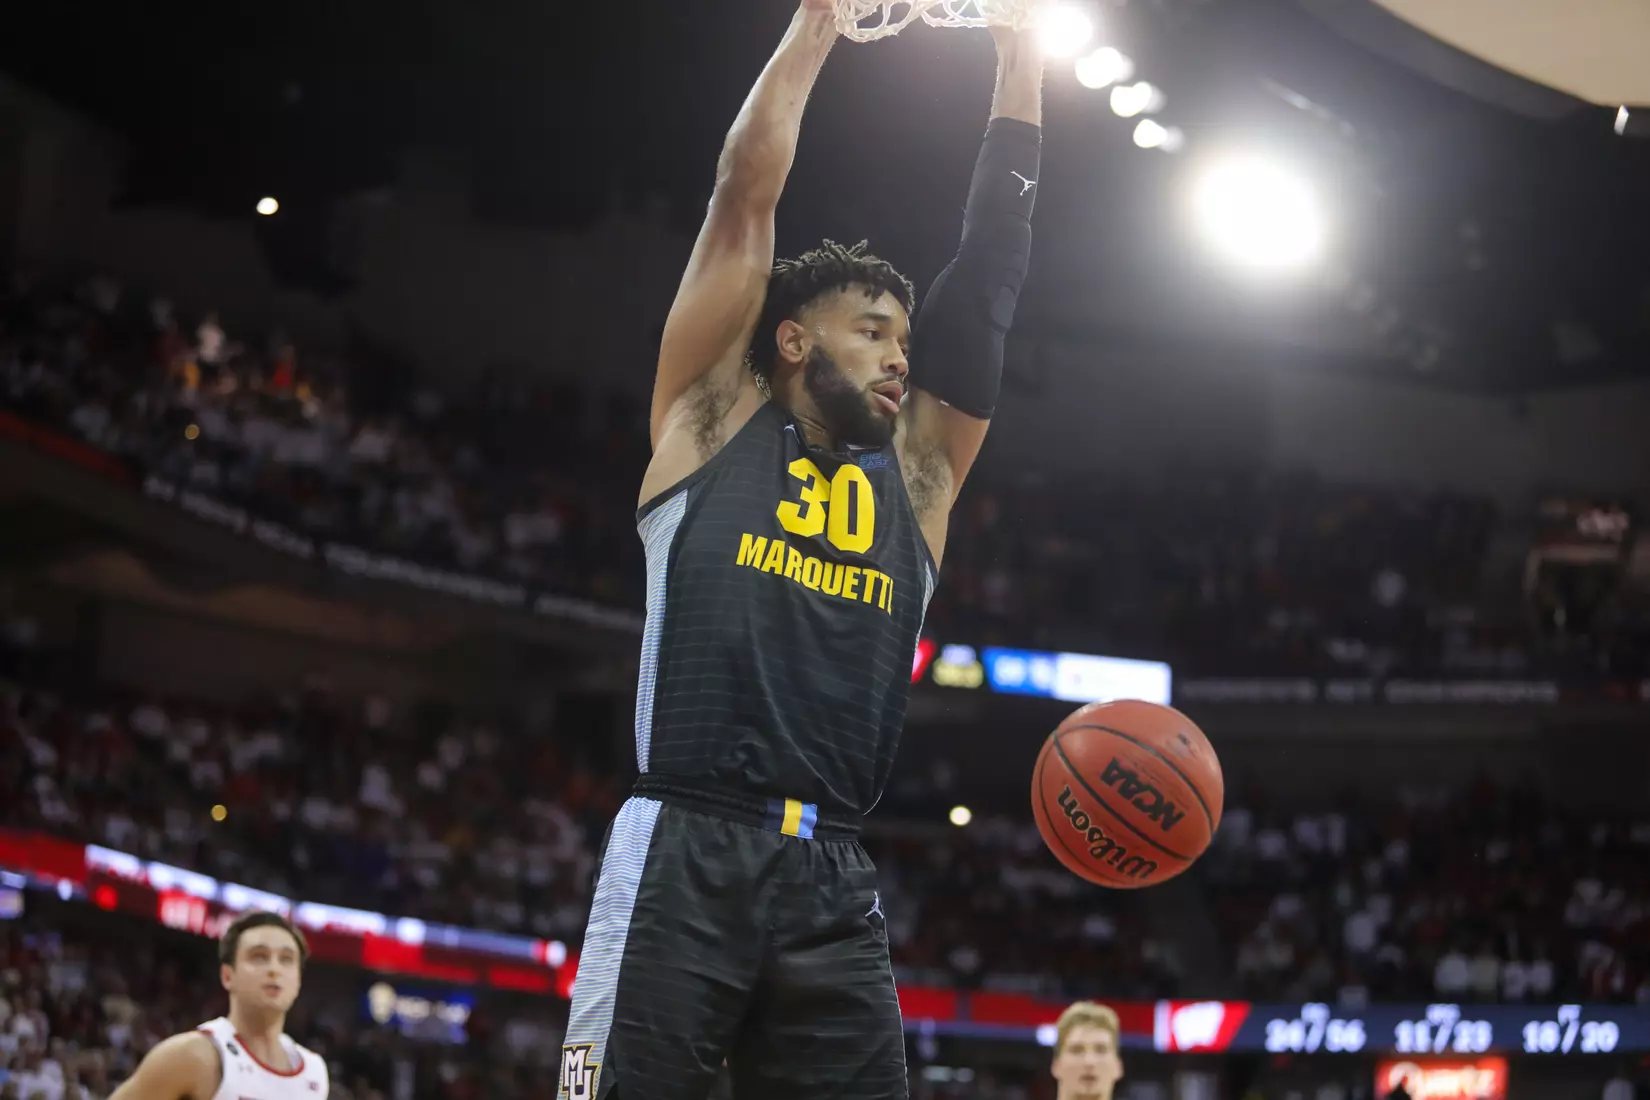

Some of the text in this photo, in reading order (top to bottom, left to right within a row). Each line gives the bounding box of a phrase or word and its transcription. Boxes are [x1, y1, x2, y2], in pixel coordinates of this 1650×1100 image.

[776, 457, 875, 554] 30
[1057, 785, 1158, 879] Wilson
[1101, 757, 1186, 832] NCAA
